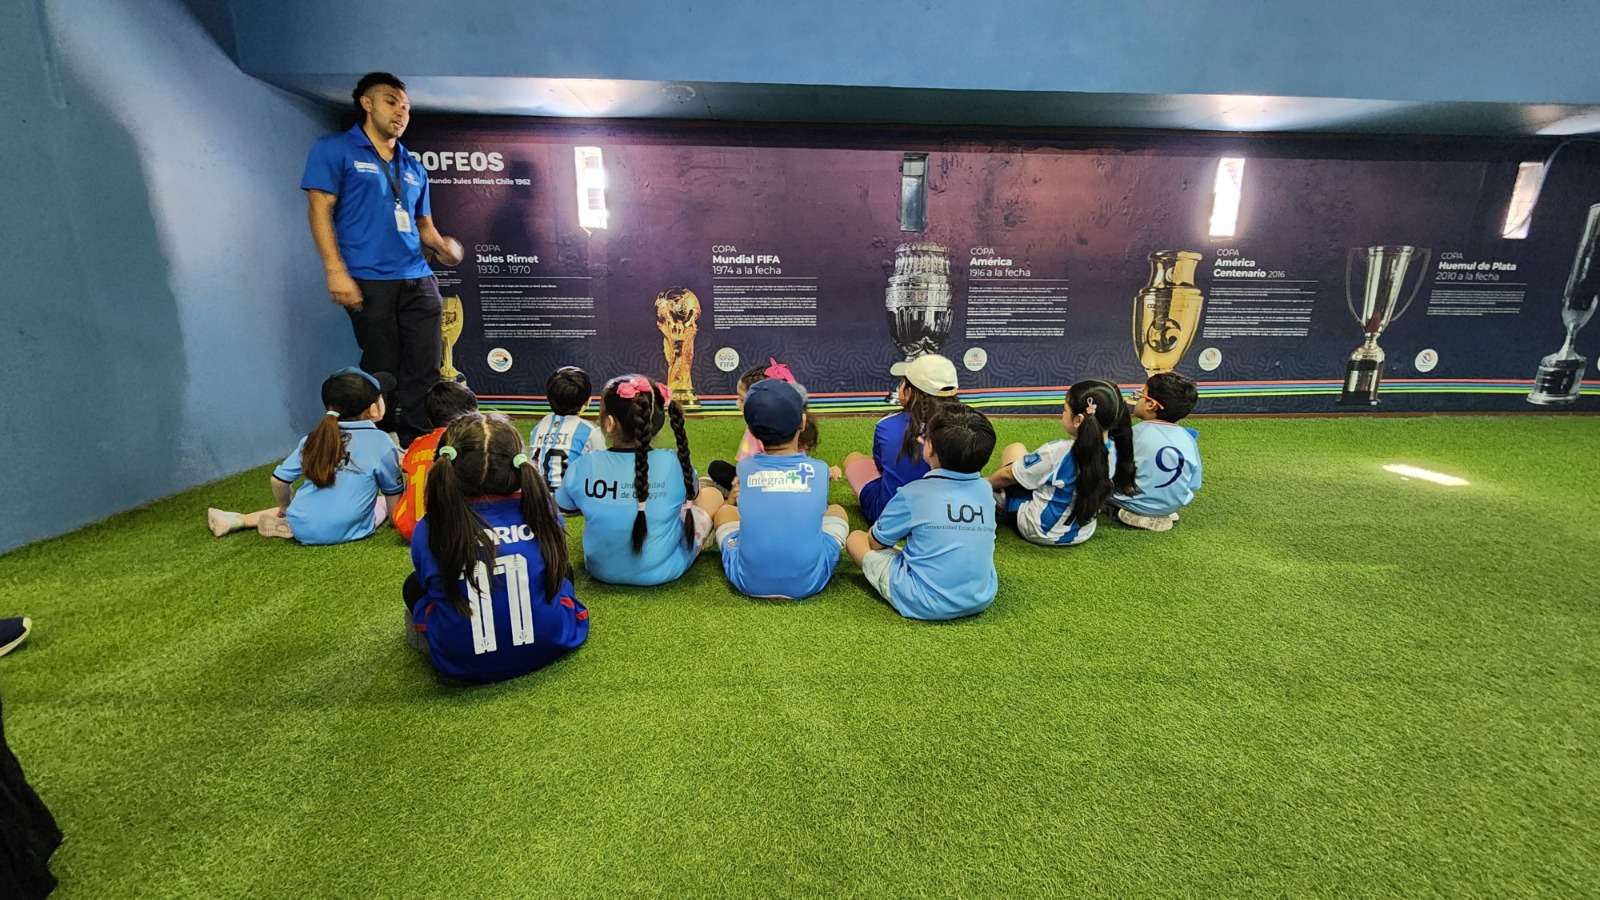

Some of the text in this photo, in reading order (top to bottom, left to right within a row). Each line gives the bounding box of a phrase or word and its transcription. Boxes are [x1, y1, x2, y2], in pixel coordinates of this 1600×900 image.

[453, 177, 471, 185] Jules
[515, 178, 531, 186] 1962
[475, 244, 501, 252] COPA
[712, 245, 737, 253] COPA
[970, 247, 995, 255] COPA
[1216, 249, 1240, 257] COPA
[1440, 252, 1463, 260] COPA
[476, 254, 539, 264] Jules Rimet
[712, 255, 781, 264] Mundial FIFA
[970, 257, 1012, 267] América
[1214, 258, 1256, 268] América
[477, 265, 499, 274] 1930
[509, 265, 531, 275] 1970
[712, 265, 734, 275] 1974
[745, 265, 753, 275] la
[755, 265, 782, 275] fecha
[1438, 262, 1517, 271] Huemul de Plata
[969, 268, 985, 277] 1916
[995, 268, 1003, 277] la
[1005, 268, 1031, 277] fecha
[1213, 269, 1286, 278] Centenario 2016
[1435, 272, 1457, 281] 2010
[1465, 272, 1474, 281] la
[1475, 272, 1500, 281] fecha
[1155, 446, 1184, 489] 9
[459, 553, 535, 655] 11
